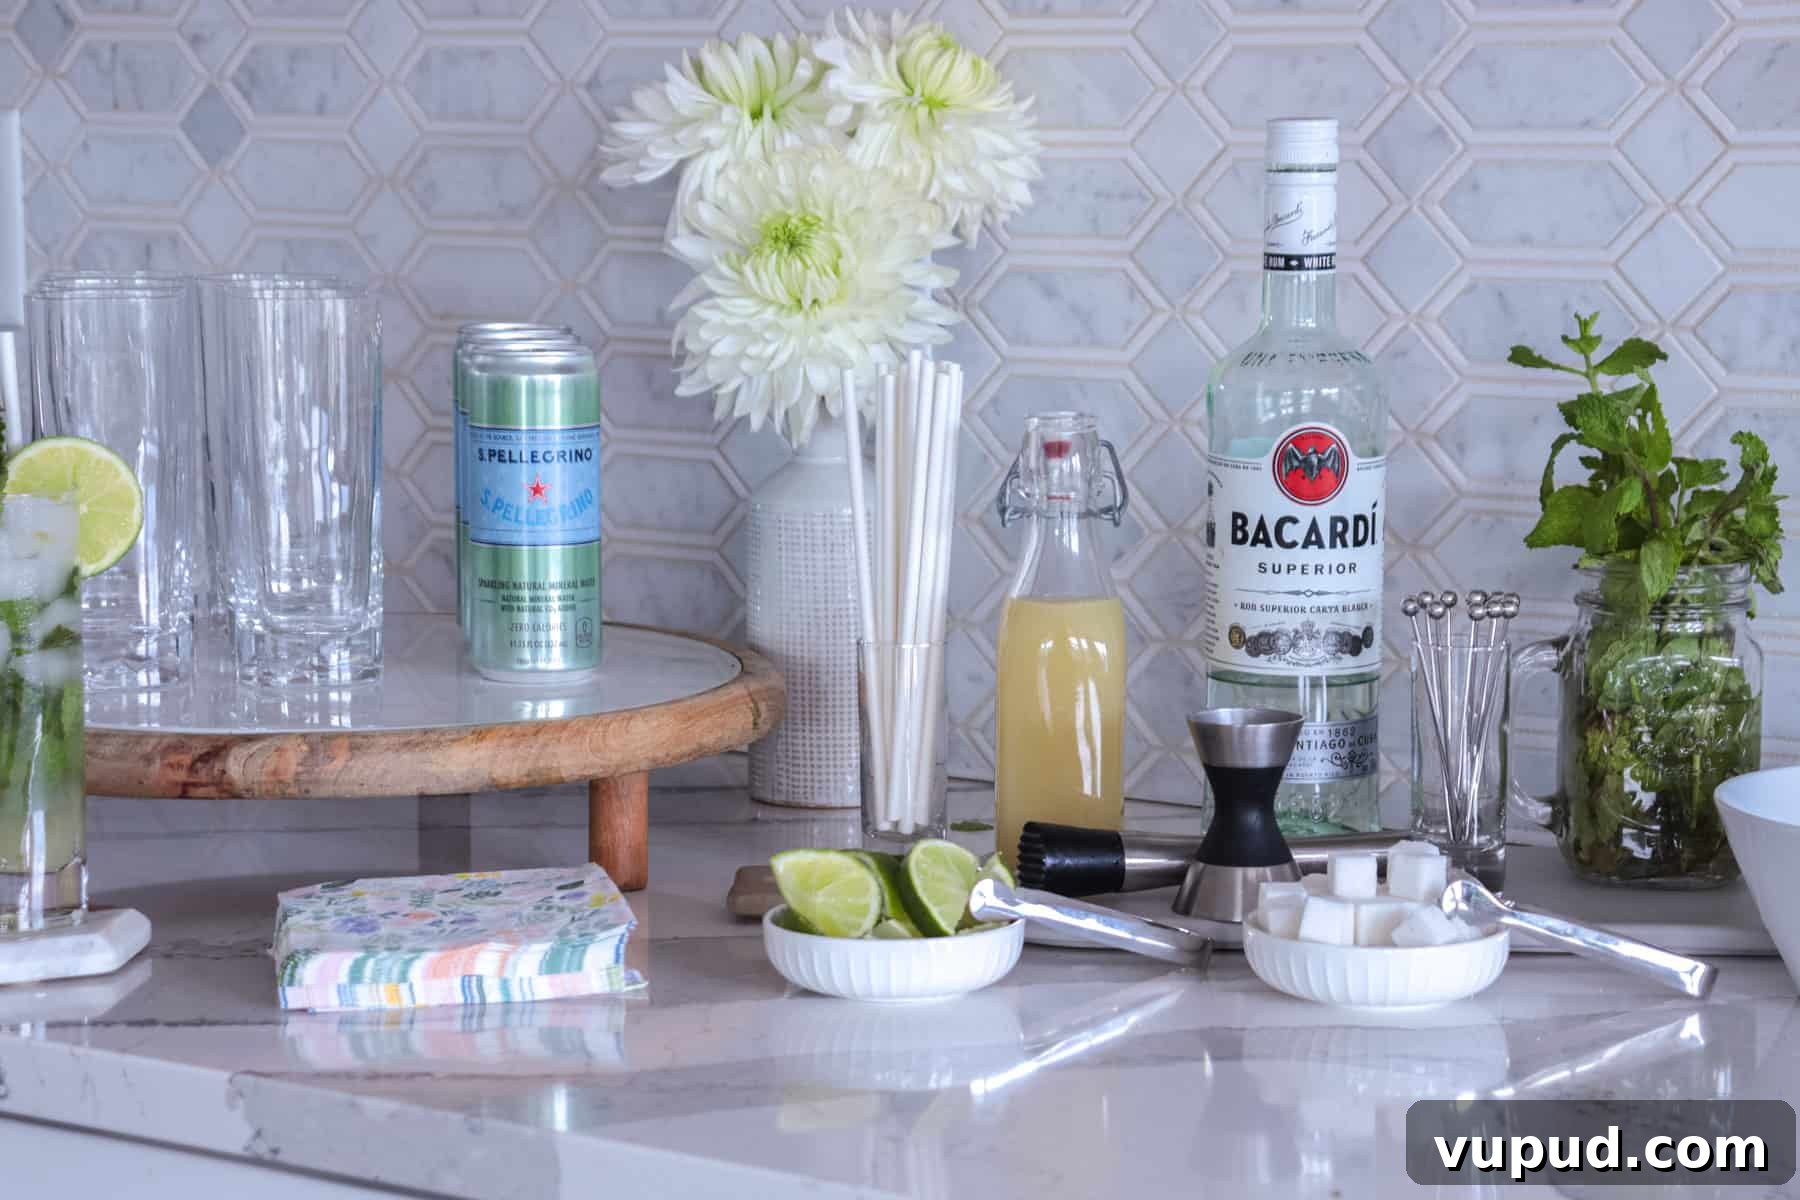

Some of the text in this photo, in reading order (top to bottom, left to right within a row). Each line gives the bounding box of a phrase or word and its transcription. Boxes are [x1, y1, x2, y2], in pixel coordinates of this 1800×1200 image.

[1304, 256, 1331, 269] WHITE
[477, 447, 593, 464] S.PELLEGRINO
[1231, 500, 1379, 549] BACARDÍ
[1257, 561, 1358, 576] SUPERIOR
[1259, 604, 1307, 615] SUPERIOR
[1309, 603, 1341, 615] CARTA
[1327, 726, 1356, 738] 1862
[1295, 738, 1346, 751] NTIAGO
